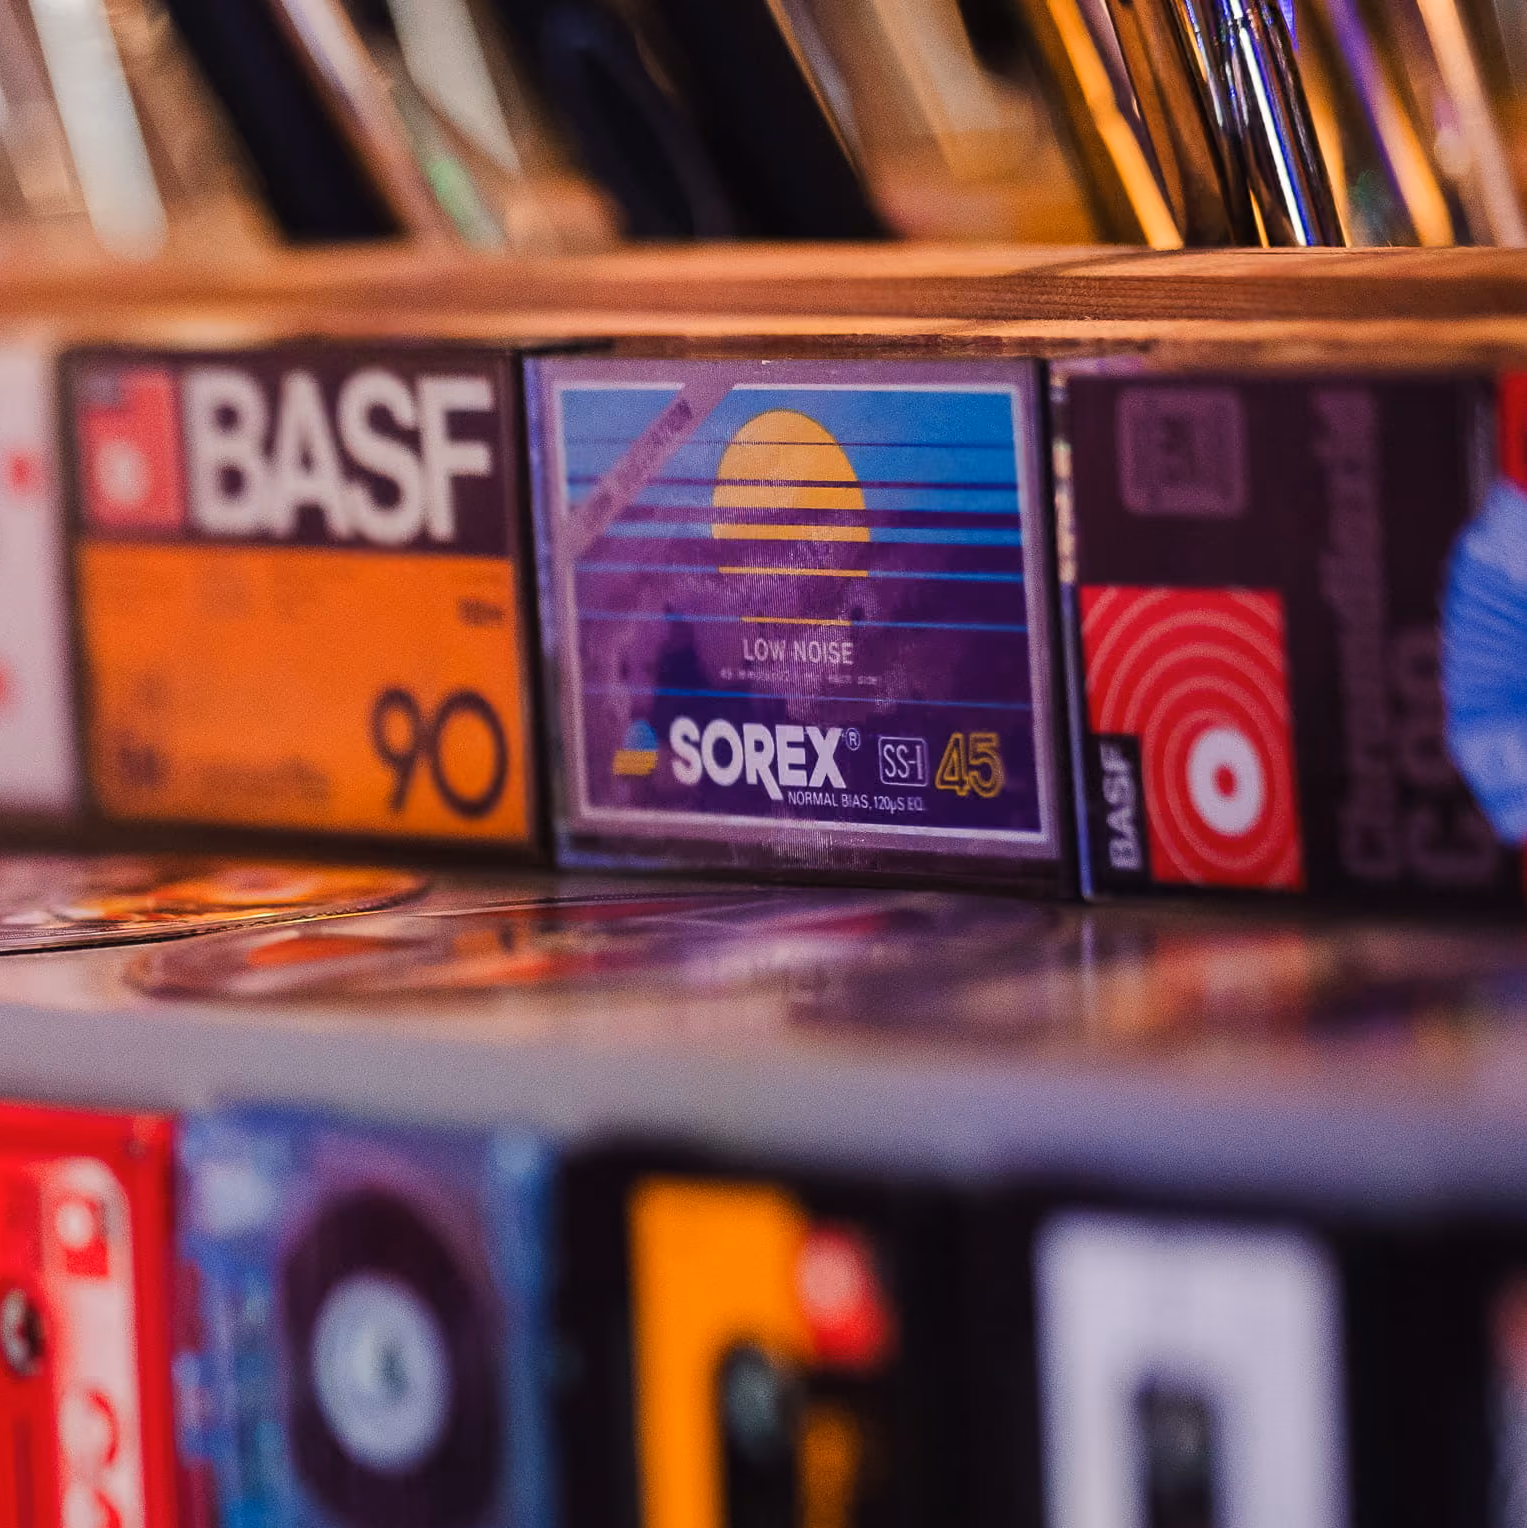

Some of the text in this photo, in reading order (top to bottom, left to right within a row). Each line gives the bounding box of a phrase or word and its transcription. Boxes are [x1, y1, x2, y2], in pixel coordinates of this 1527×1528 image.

[181, 366, 493, 545] BASF
[743, 638, 854, 665] LOW NOISE
[369, 685, 509, 821] 90
[787, 790, 838, 808] NORMAL
[935, 731, 1004, 799] 45
[1099, 742, 1143, 871] BASF
